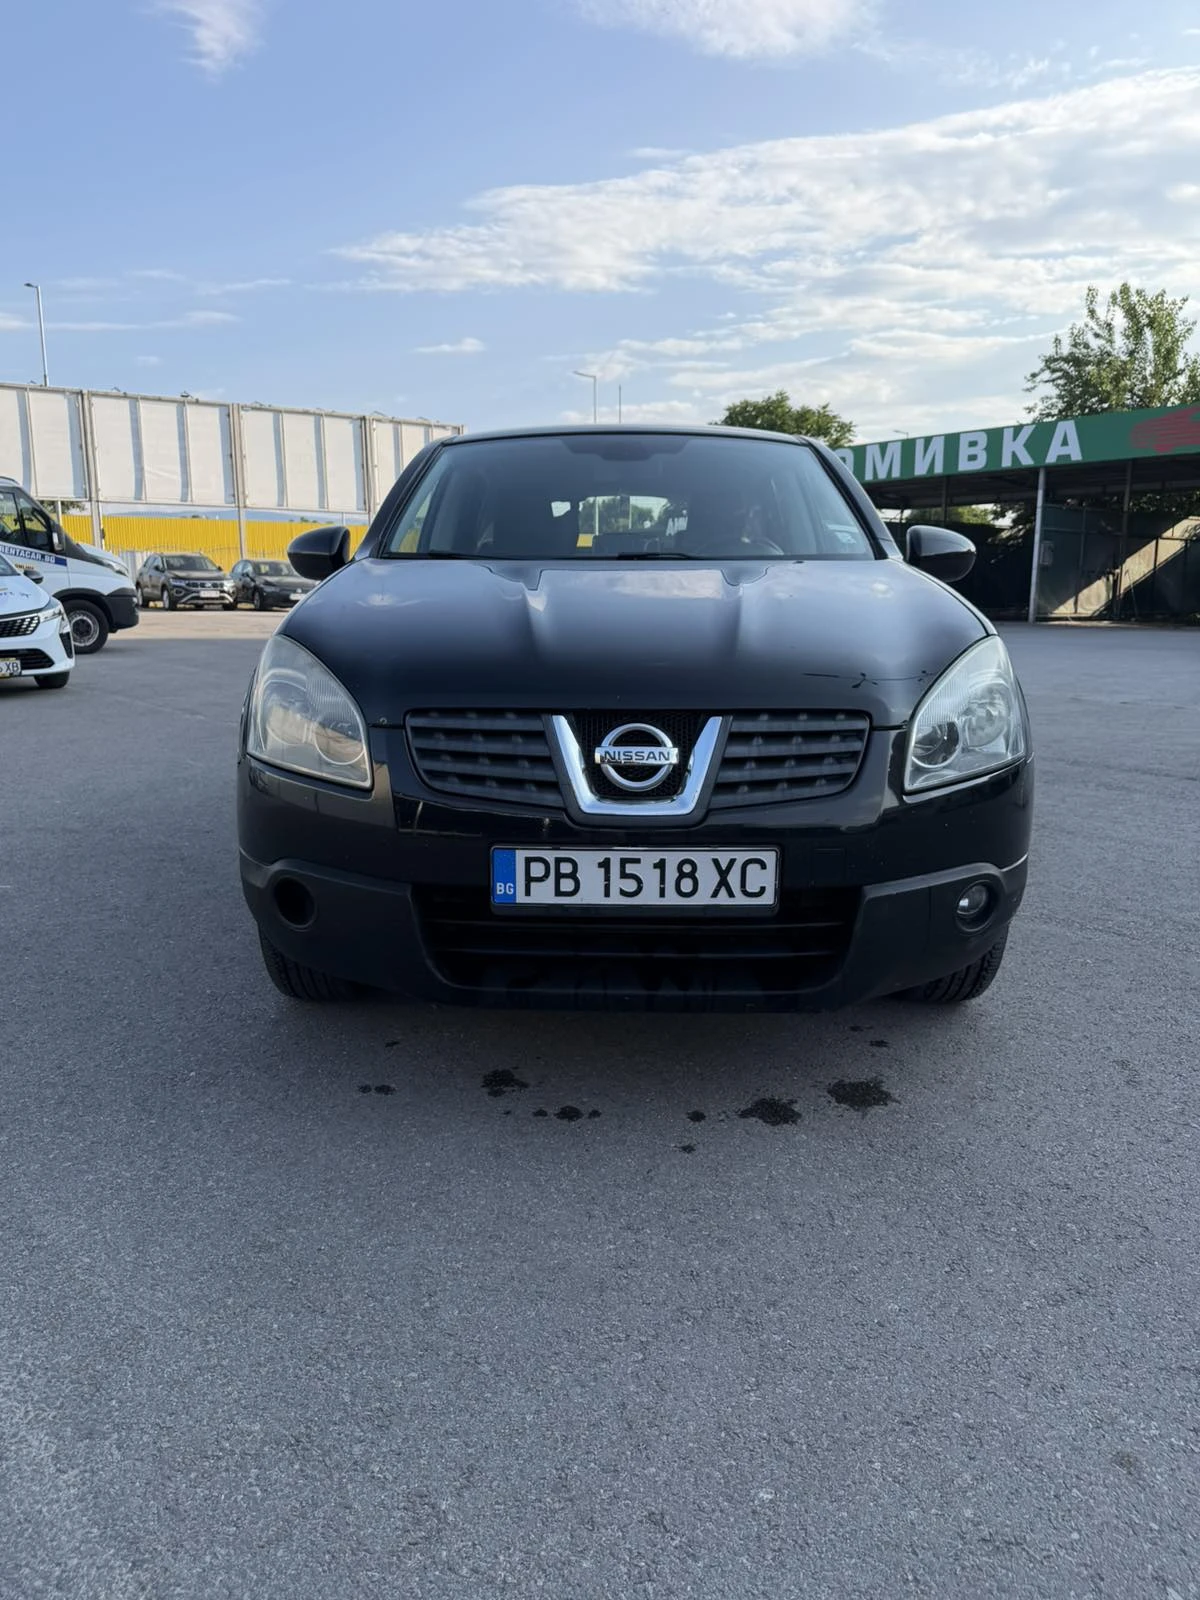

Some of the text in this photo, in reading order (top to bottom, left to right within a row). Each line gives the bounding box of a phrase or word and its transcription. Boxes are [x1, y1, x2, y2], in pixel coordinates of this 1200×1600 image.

[604, 750, 671, 761] NISSAN
[524, 856, 768, 898] PB 1518 XC
[496, 883, 514, 894] BG
